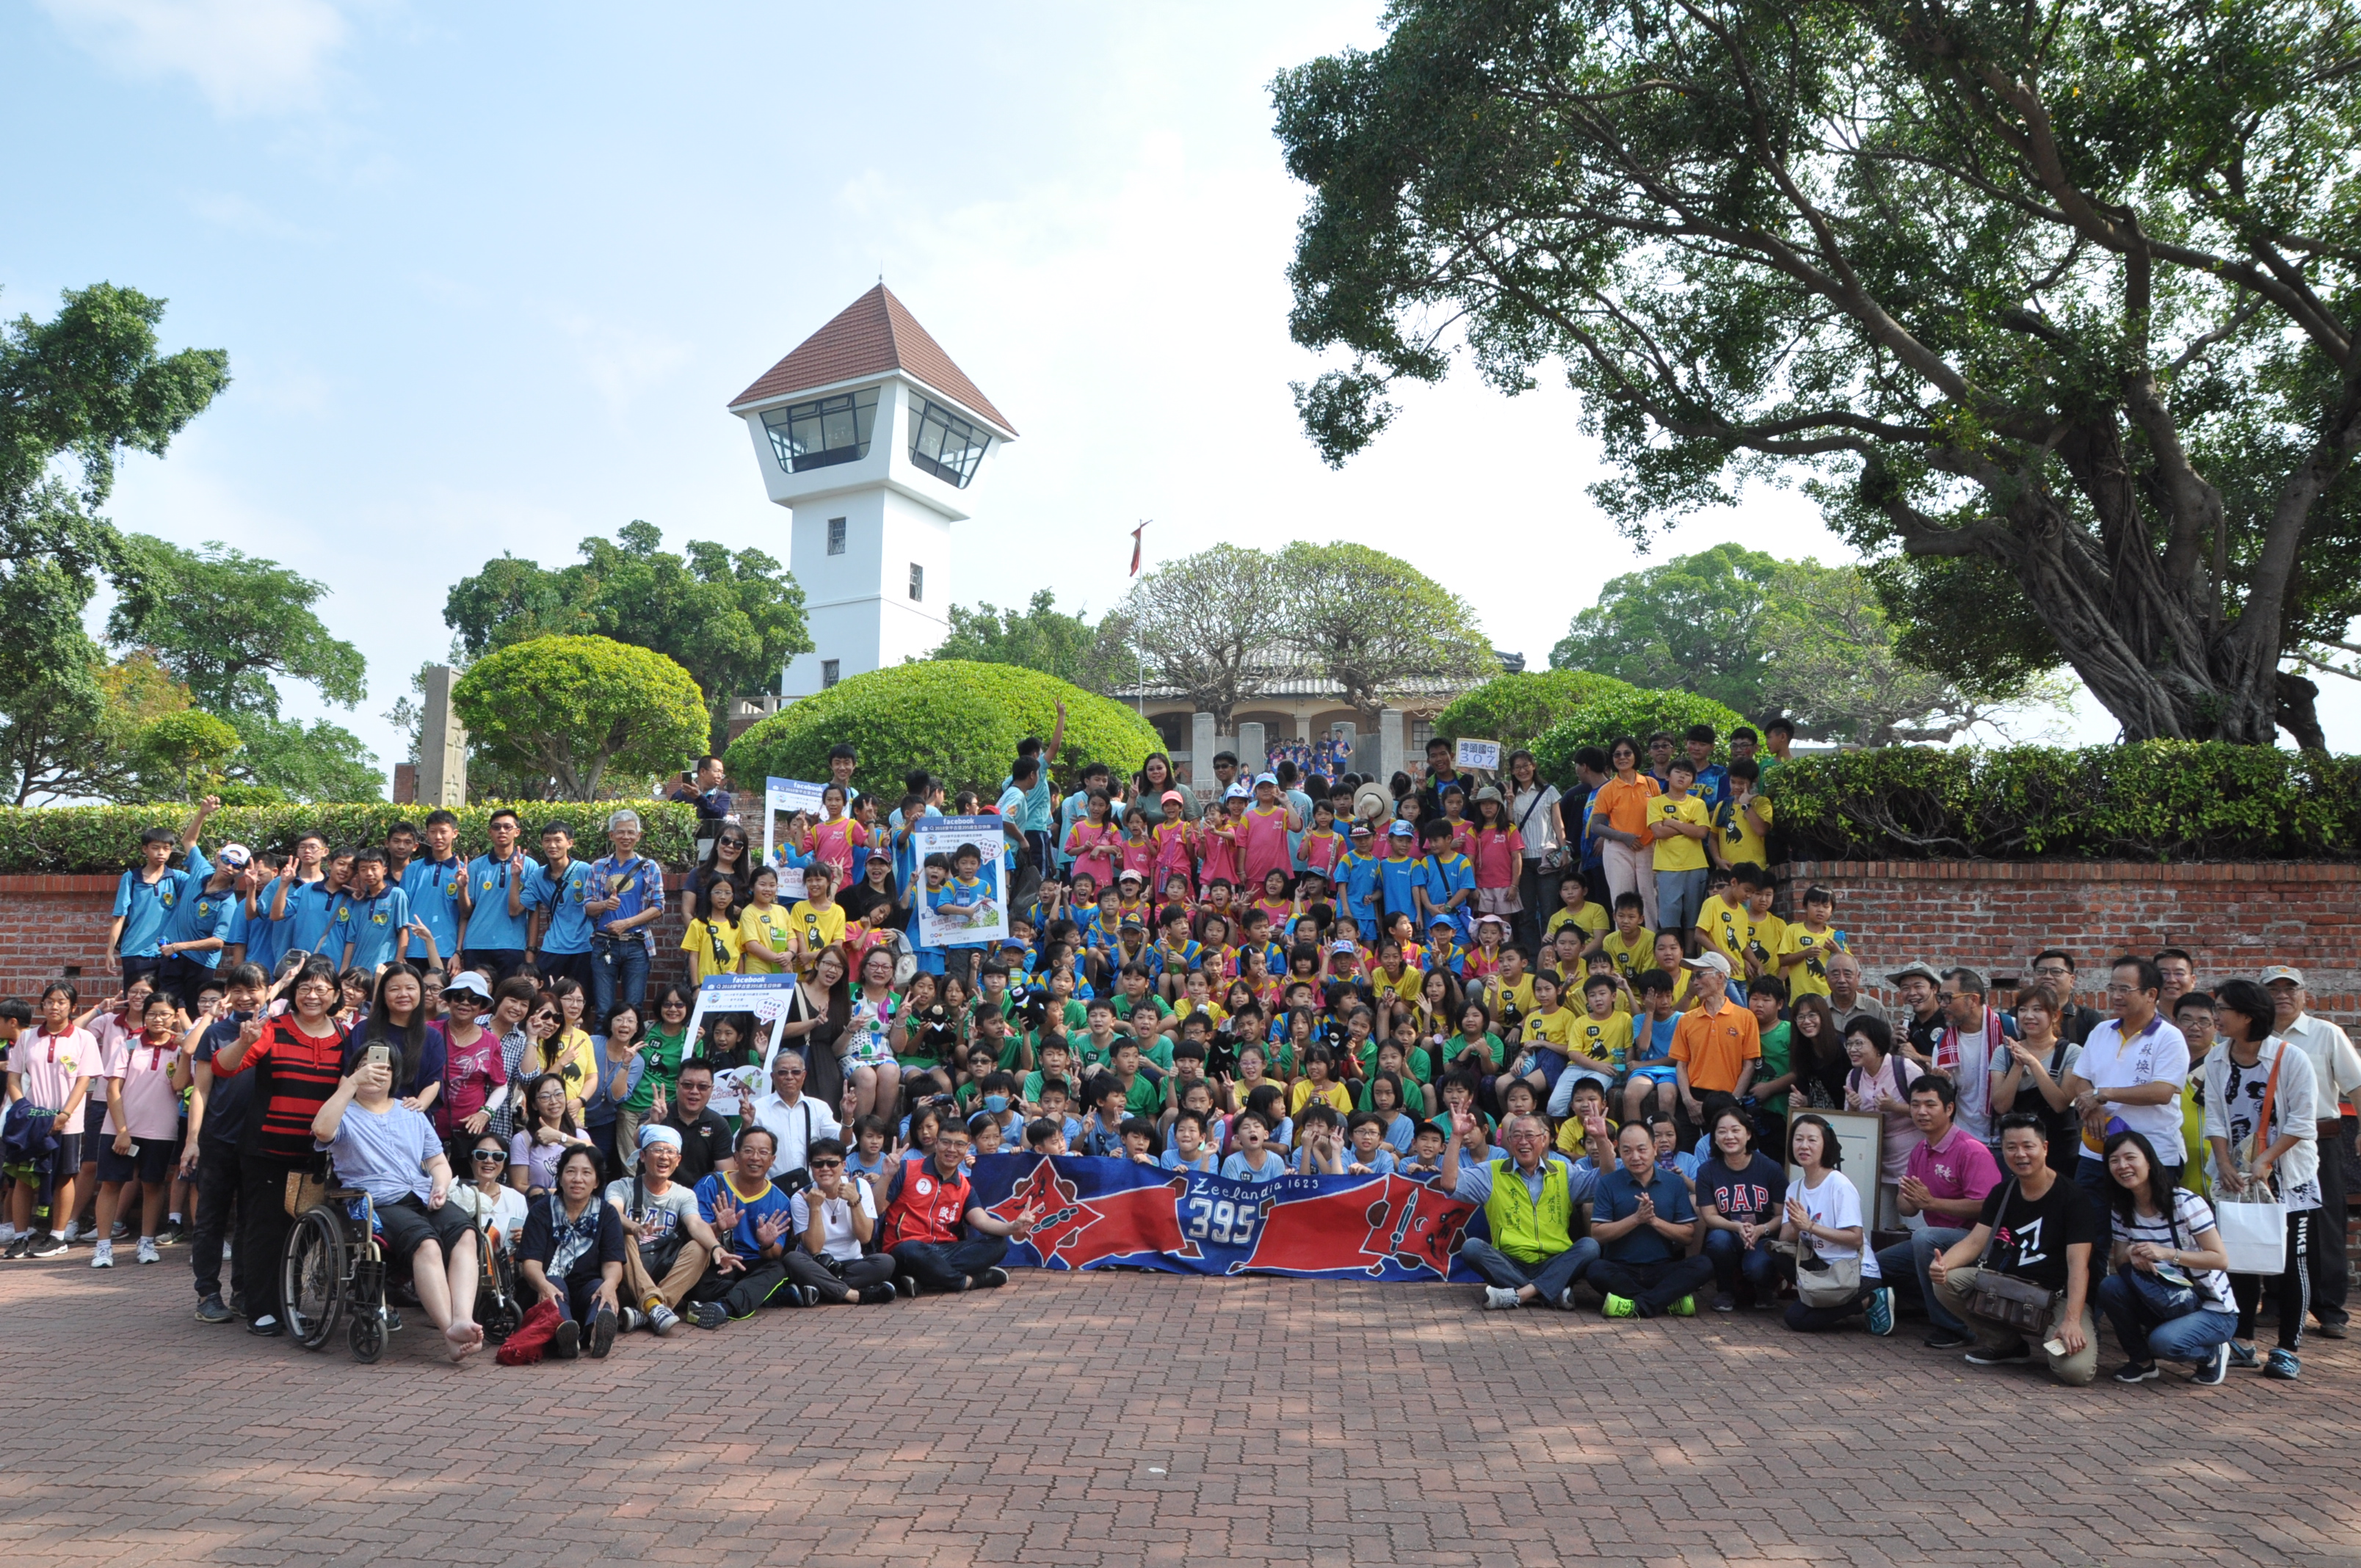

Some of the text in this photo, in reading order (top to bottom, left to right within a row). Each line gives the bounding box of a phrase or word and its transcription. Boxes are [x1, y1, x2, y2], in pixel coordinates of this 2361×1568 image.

[1460, 742, 1496, 755] 埤頭國中
[1461, 752, 1495, 765] 307
[794, 782, 823, 792] facebook
[920, 1180, 927, 1191] 2
[1191, 1177, 1319, 1200] Zeelandia 1623
[1714, 1184, 1769, 1213] GAP
[1189, 1197, 1256, 1244] 395
[2296, 1216, 2309, 1255] NIKE
